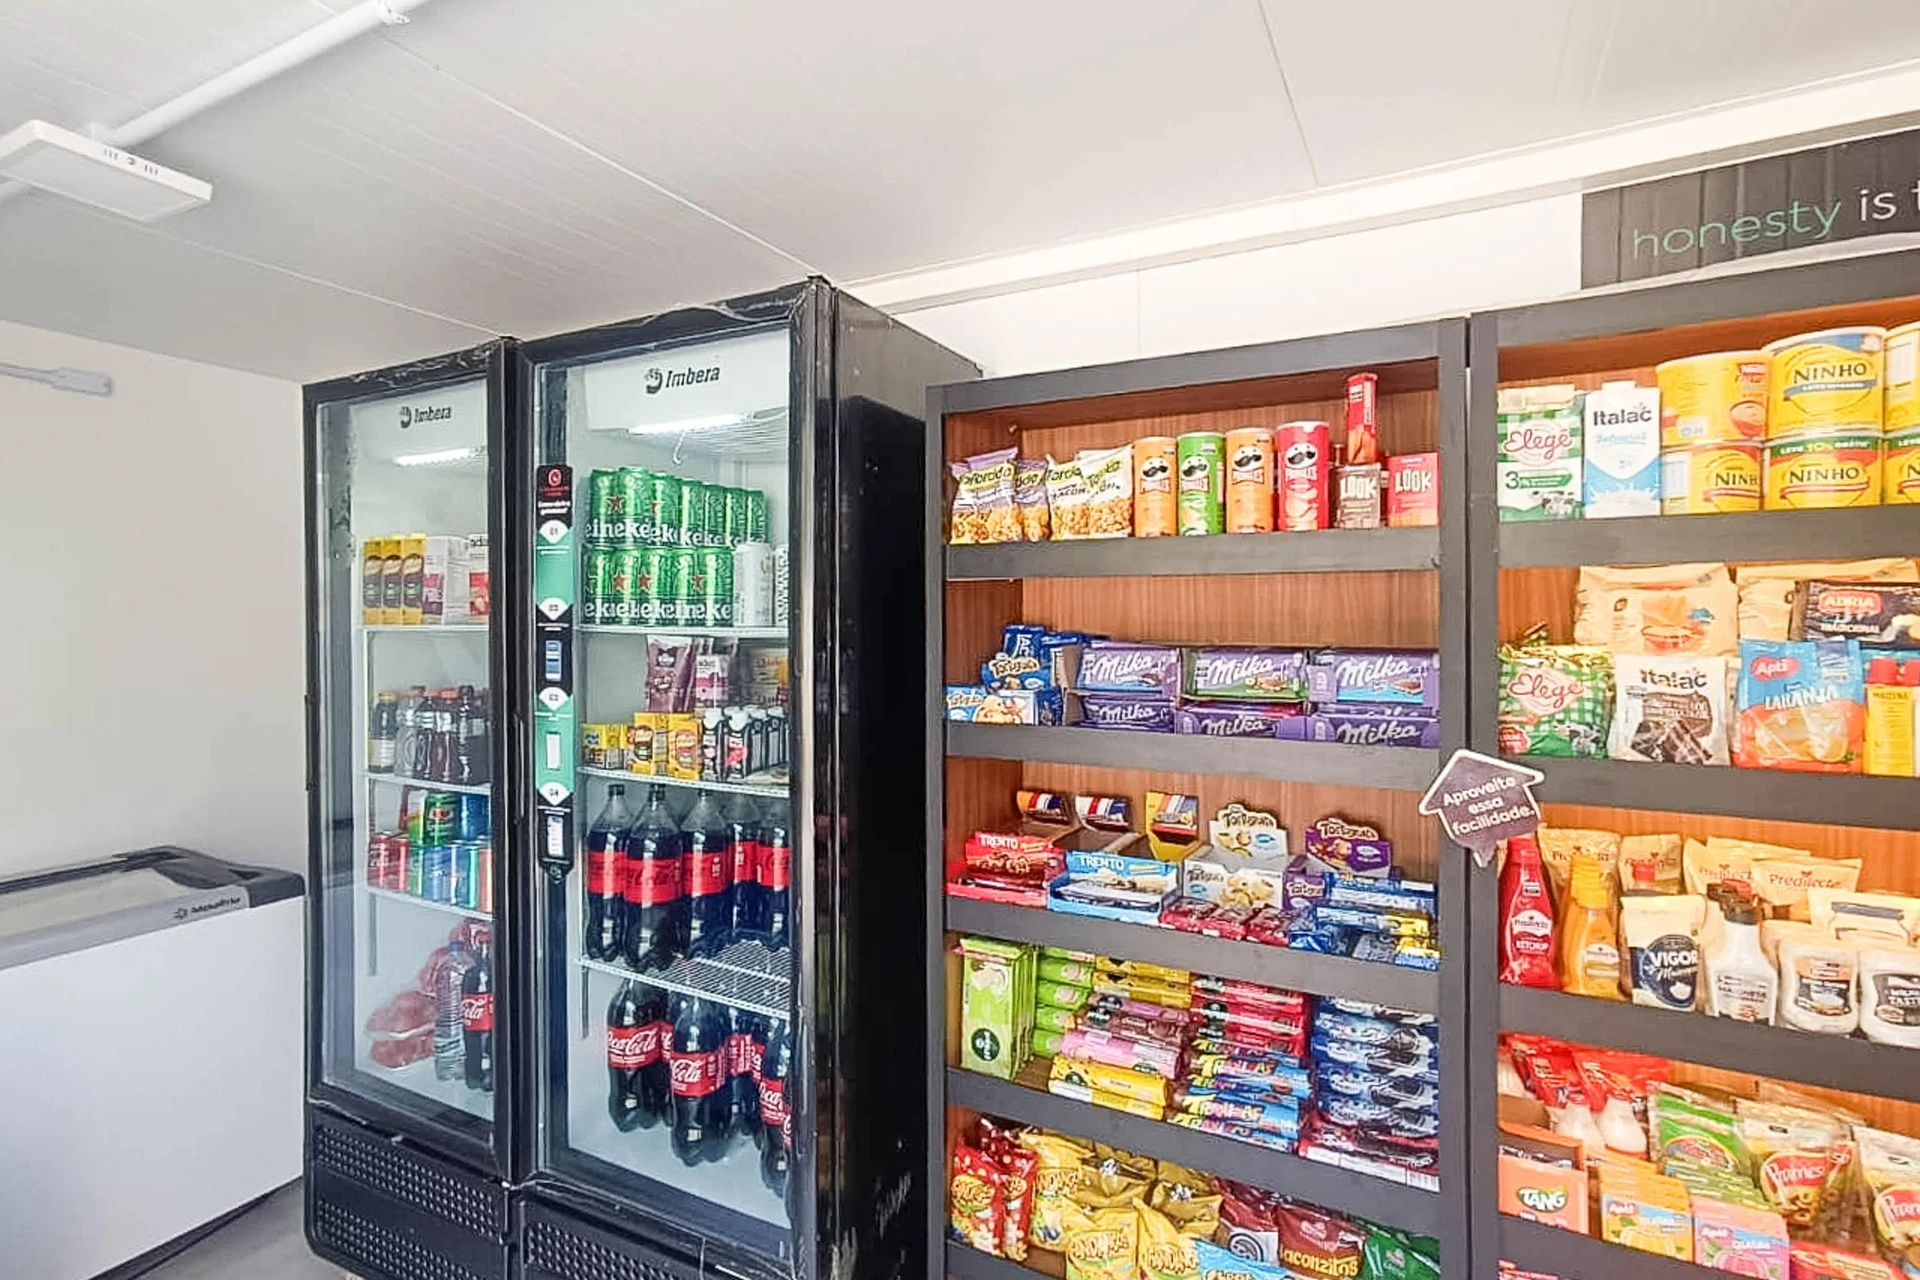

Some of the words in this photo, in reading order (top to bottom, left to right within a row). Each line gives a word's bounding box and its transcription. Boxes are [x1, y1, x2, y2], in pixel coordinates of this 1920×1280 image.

[1633, 200, 1842, 260] honesty
[1859, 187, 1898, 222] is
[665, 367, 721, 388] Imbera
[1793, 362, 1868, 384] NINHO
[1394, 469, 1433, 493] LOOK
[1789, 467, 1860, 484] NINHO
[1340, 476, 1378, 500] LOOK
[1093, 651, 1155, 683] Milka
[1207, 653, 1276, 685] Milka
[1335, 655, 1414, 688] Milka
[1756, 658, 1790, 678] Apti
[1763, 683, 1841, 711] LARANJA
[1100, 703, 1156, 723] Milka
[1201, 715, 1268, 736] Milka
[1336, 719, 1421, 745] Milka
[1443, 776, 1516, 807] Aproveite
[1467, 796, 1505, 815] essa
[979, 833, 1019, 850] TRENTO
[1079, 855, 1126, 872] TRENTO
[1518, 1188, 1567, 1211] TANG
[1281, 1248, 1360, 1277] aconzitos
